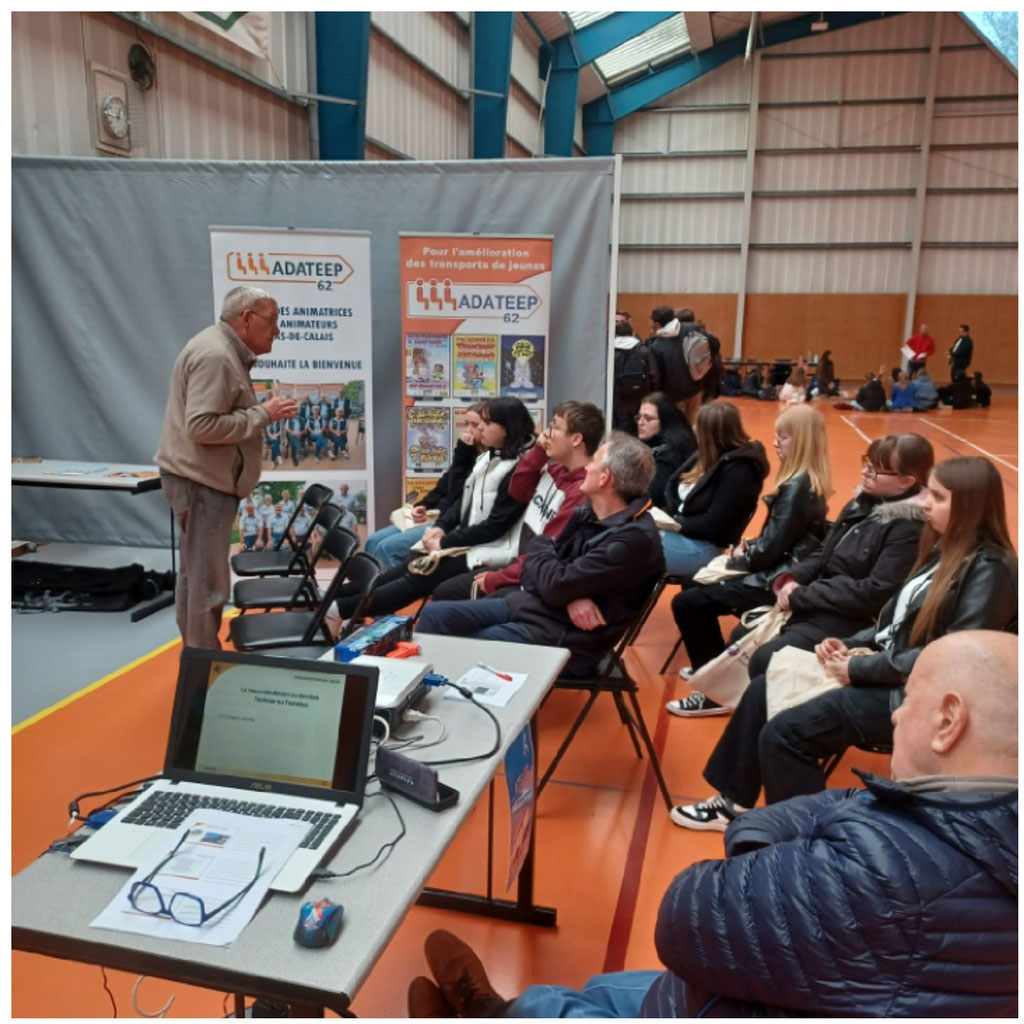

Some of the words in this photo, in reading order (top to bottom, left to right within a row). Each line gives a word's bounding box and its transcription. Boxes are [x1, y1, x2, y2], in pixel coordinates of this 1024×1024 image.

[423, 247, 449, 256] Pour
[452, 247, 530, 257] l'amélioration
[272, 261, 343, 277] ADATEEP
[406, 259, 425, 268] des
[429, 260, 489, 271] transports
[492, 261, 506, 270] de
[508, 261, 546, 272] jeunes
[317, 280, 333, 291] 62
[458, 294, 538, 310] ADATEEP
[293, 308, 353, 317] ANIMATRICES
[503, 313, 520, 324] 62
[280, 320, 338, 329] ANIMATEURS
[254, 360, 296, 369] OUHAITE
[300, 360, 312, 369] LA
[313, 360, 362, 370] BIENVENUE
